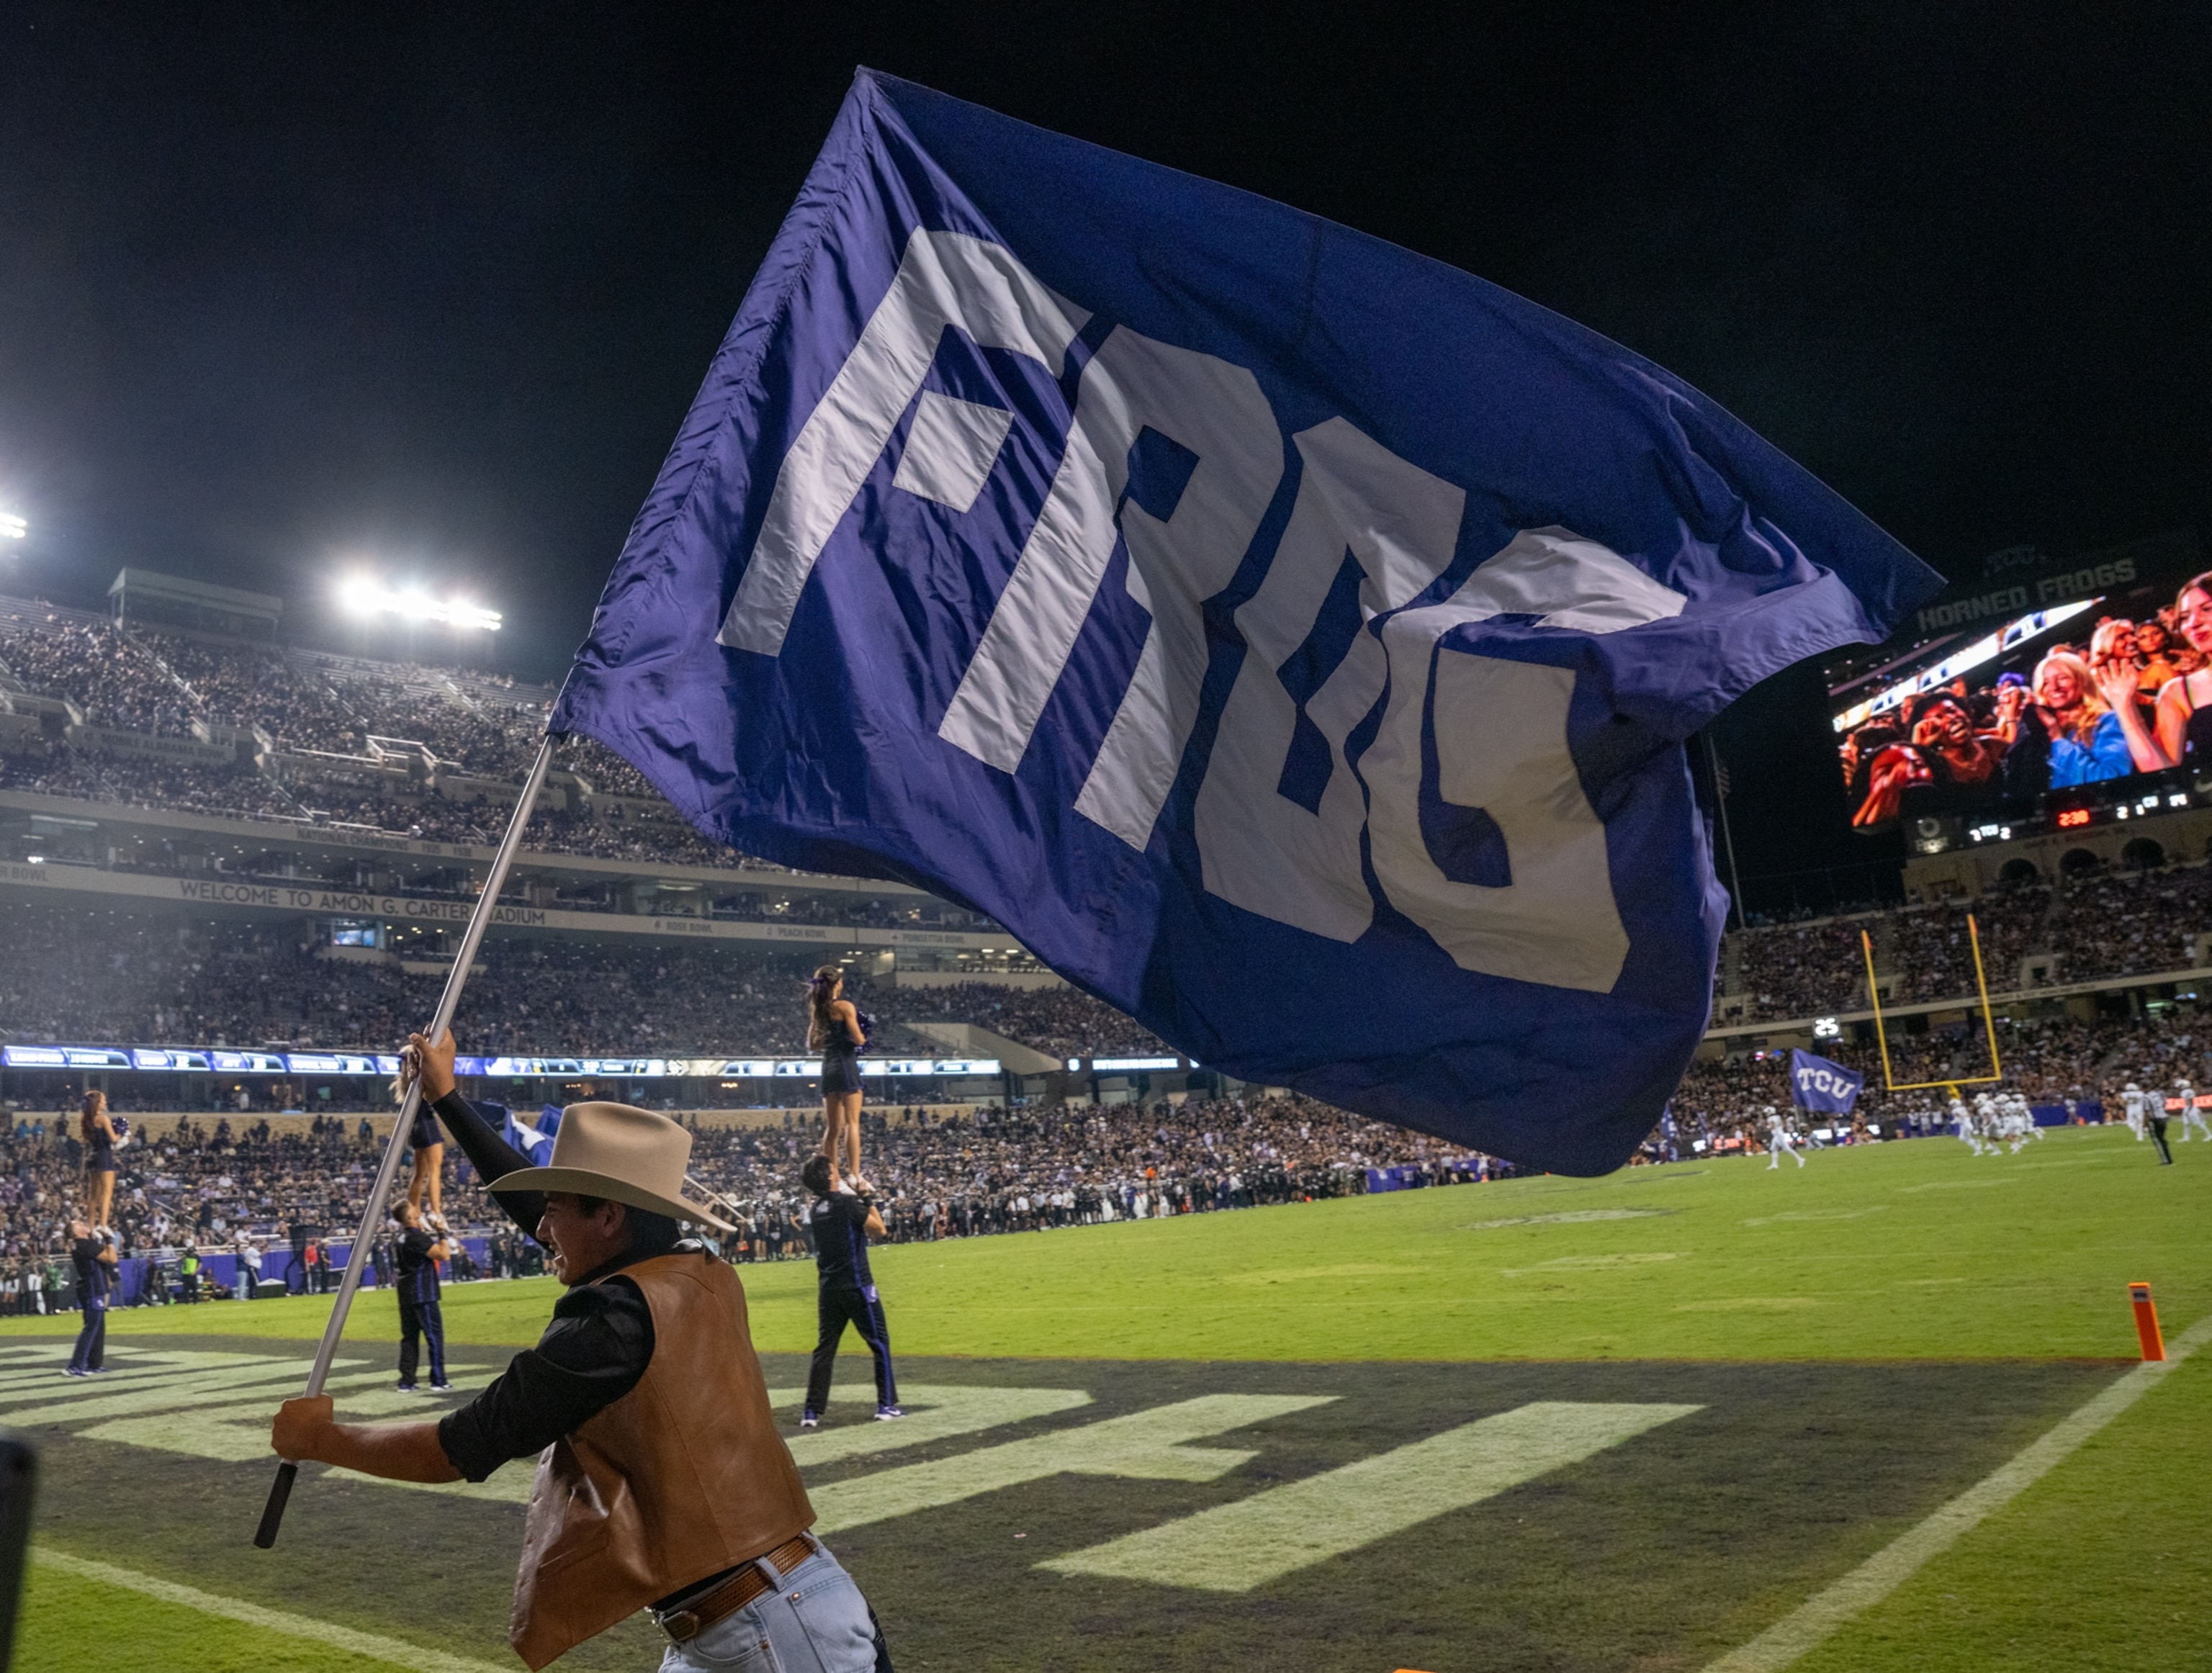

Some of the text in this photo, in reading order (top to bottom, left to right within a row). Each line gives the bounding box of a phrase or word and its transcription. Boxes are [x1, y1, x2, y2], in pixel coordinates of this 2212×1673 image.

[1917, 557, 2136, 632] HORNED FROGS
[297, 828, 347, 844] NATIONAL
[11, 866, 49, 881] BOWL
[179, 880, 546, 925] WELCOME TO AMON G. CARTER TADIUM
[667, 921, 712, 933] ROSE BOWL
[778, 927, 803, 937] PEACH
[1815, 1017, 1840, 1037] 25
[1797, 1067, 1856, 1100] TCU
